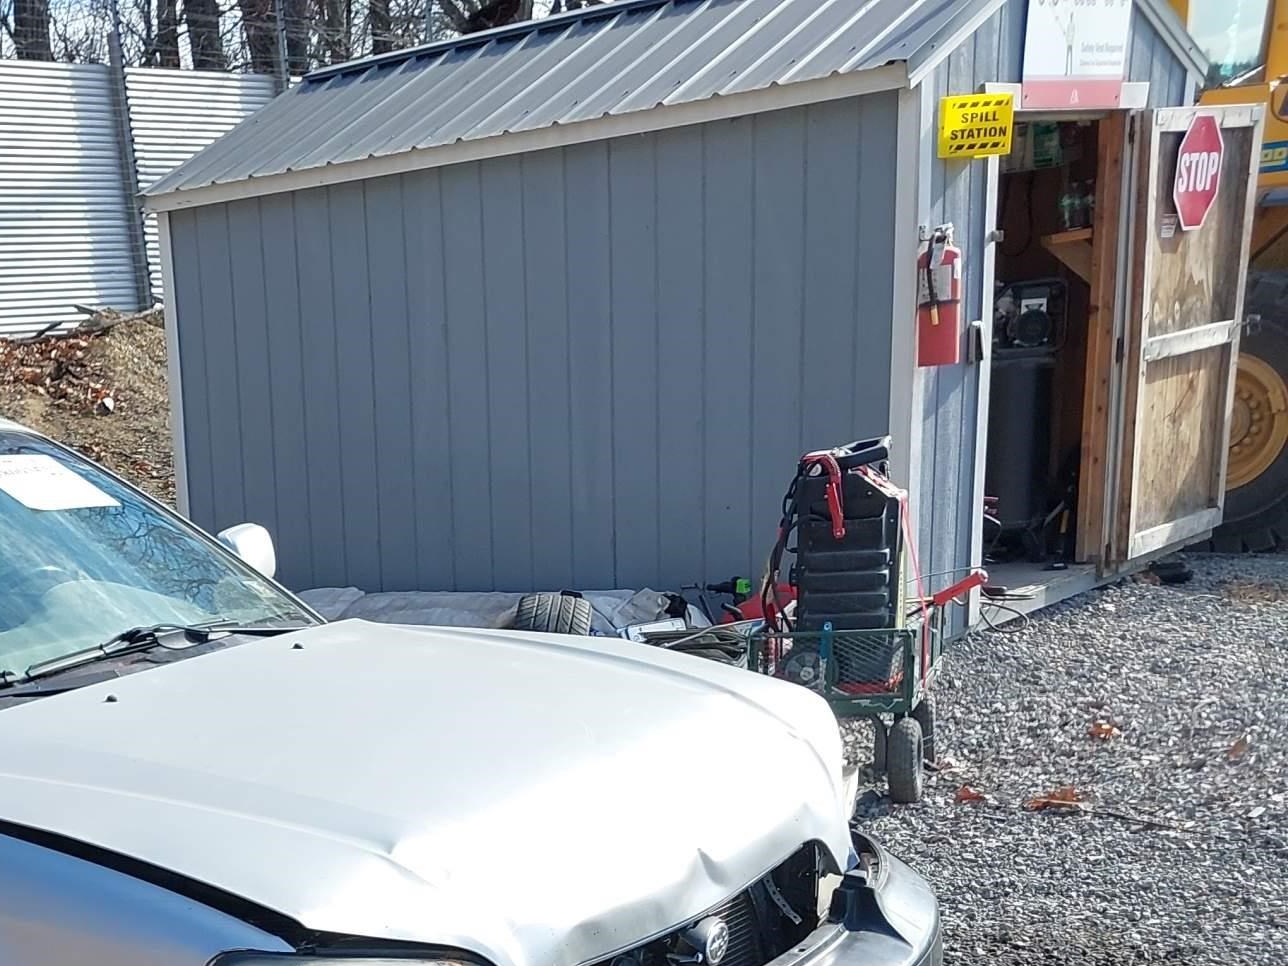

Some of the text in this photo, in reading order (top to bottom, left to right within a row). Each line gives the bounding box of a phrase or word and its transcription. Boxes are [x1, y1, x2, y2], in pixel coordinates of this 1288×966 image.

[960, 111, 1000, 124] SPILL
[950, 126, 1008, 141] STATION
[1177, 151, 1220, 193] STOP
